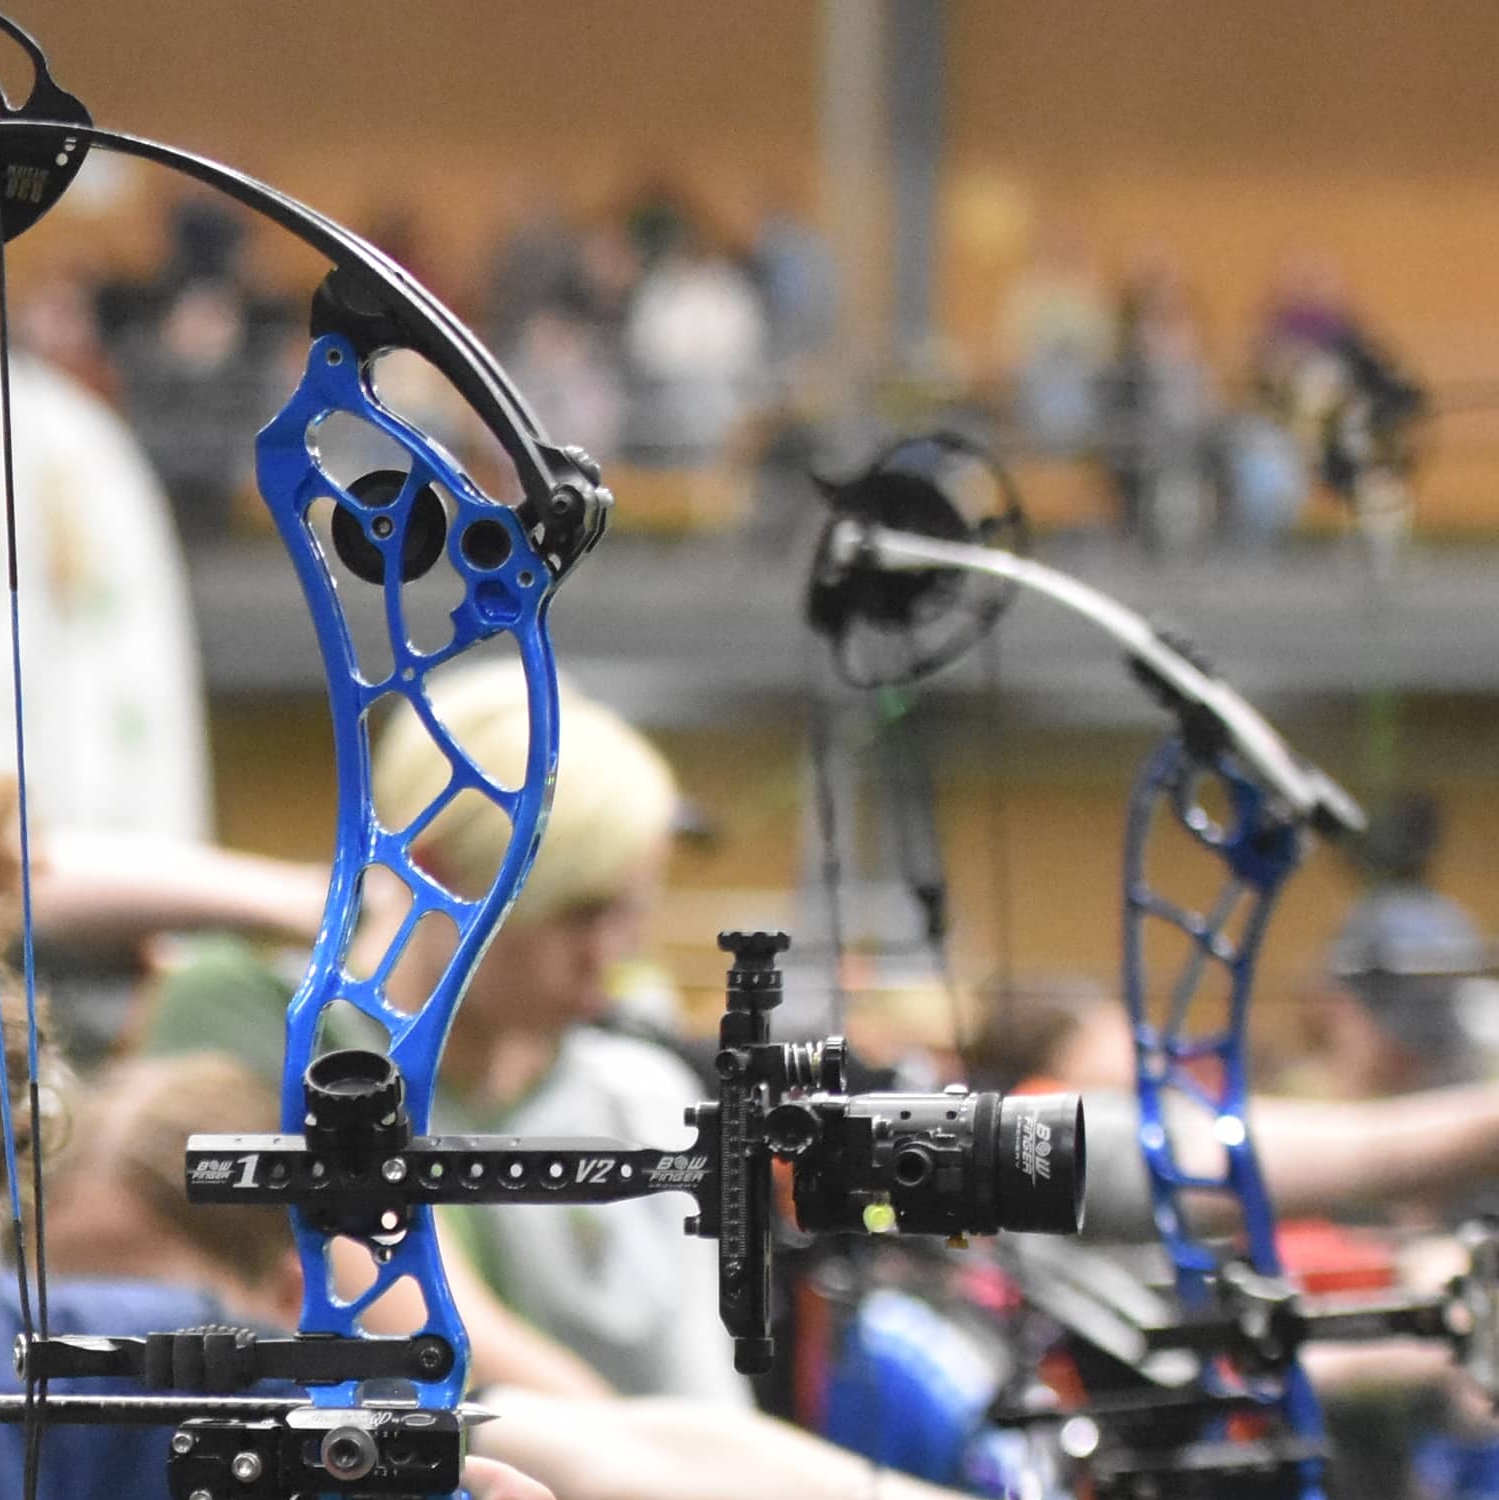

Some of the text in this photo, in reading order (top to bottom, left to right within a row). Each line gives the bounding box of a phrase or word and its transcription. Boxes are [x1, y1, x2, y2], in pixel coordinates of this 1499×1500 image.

[1021, 1115, 1034, 1175] FINGER
[1035, 1122, 1052, 1180] BOW
[196, 1159, 234, 1171] BOW
[232, 1153, 260, 1189] 1
[575, 1158, 616, 1184] V2
[655, 1155, 709, 1171] BOW
[648, 1171, 705, 1182] FINGER
